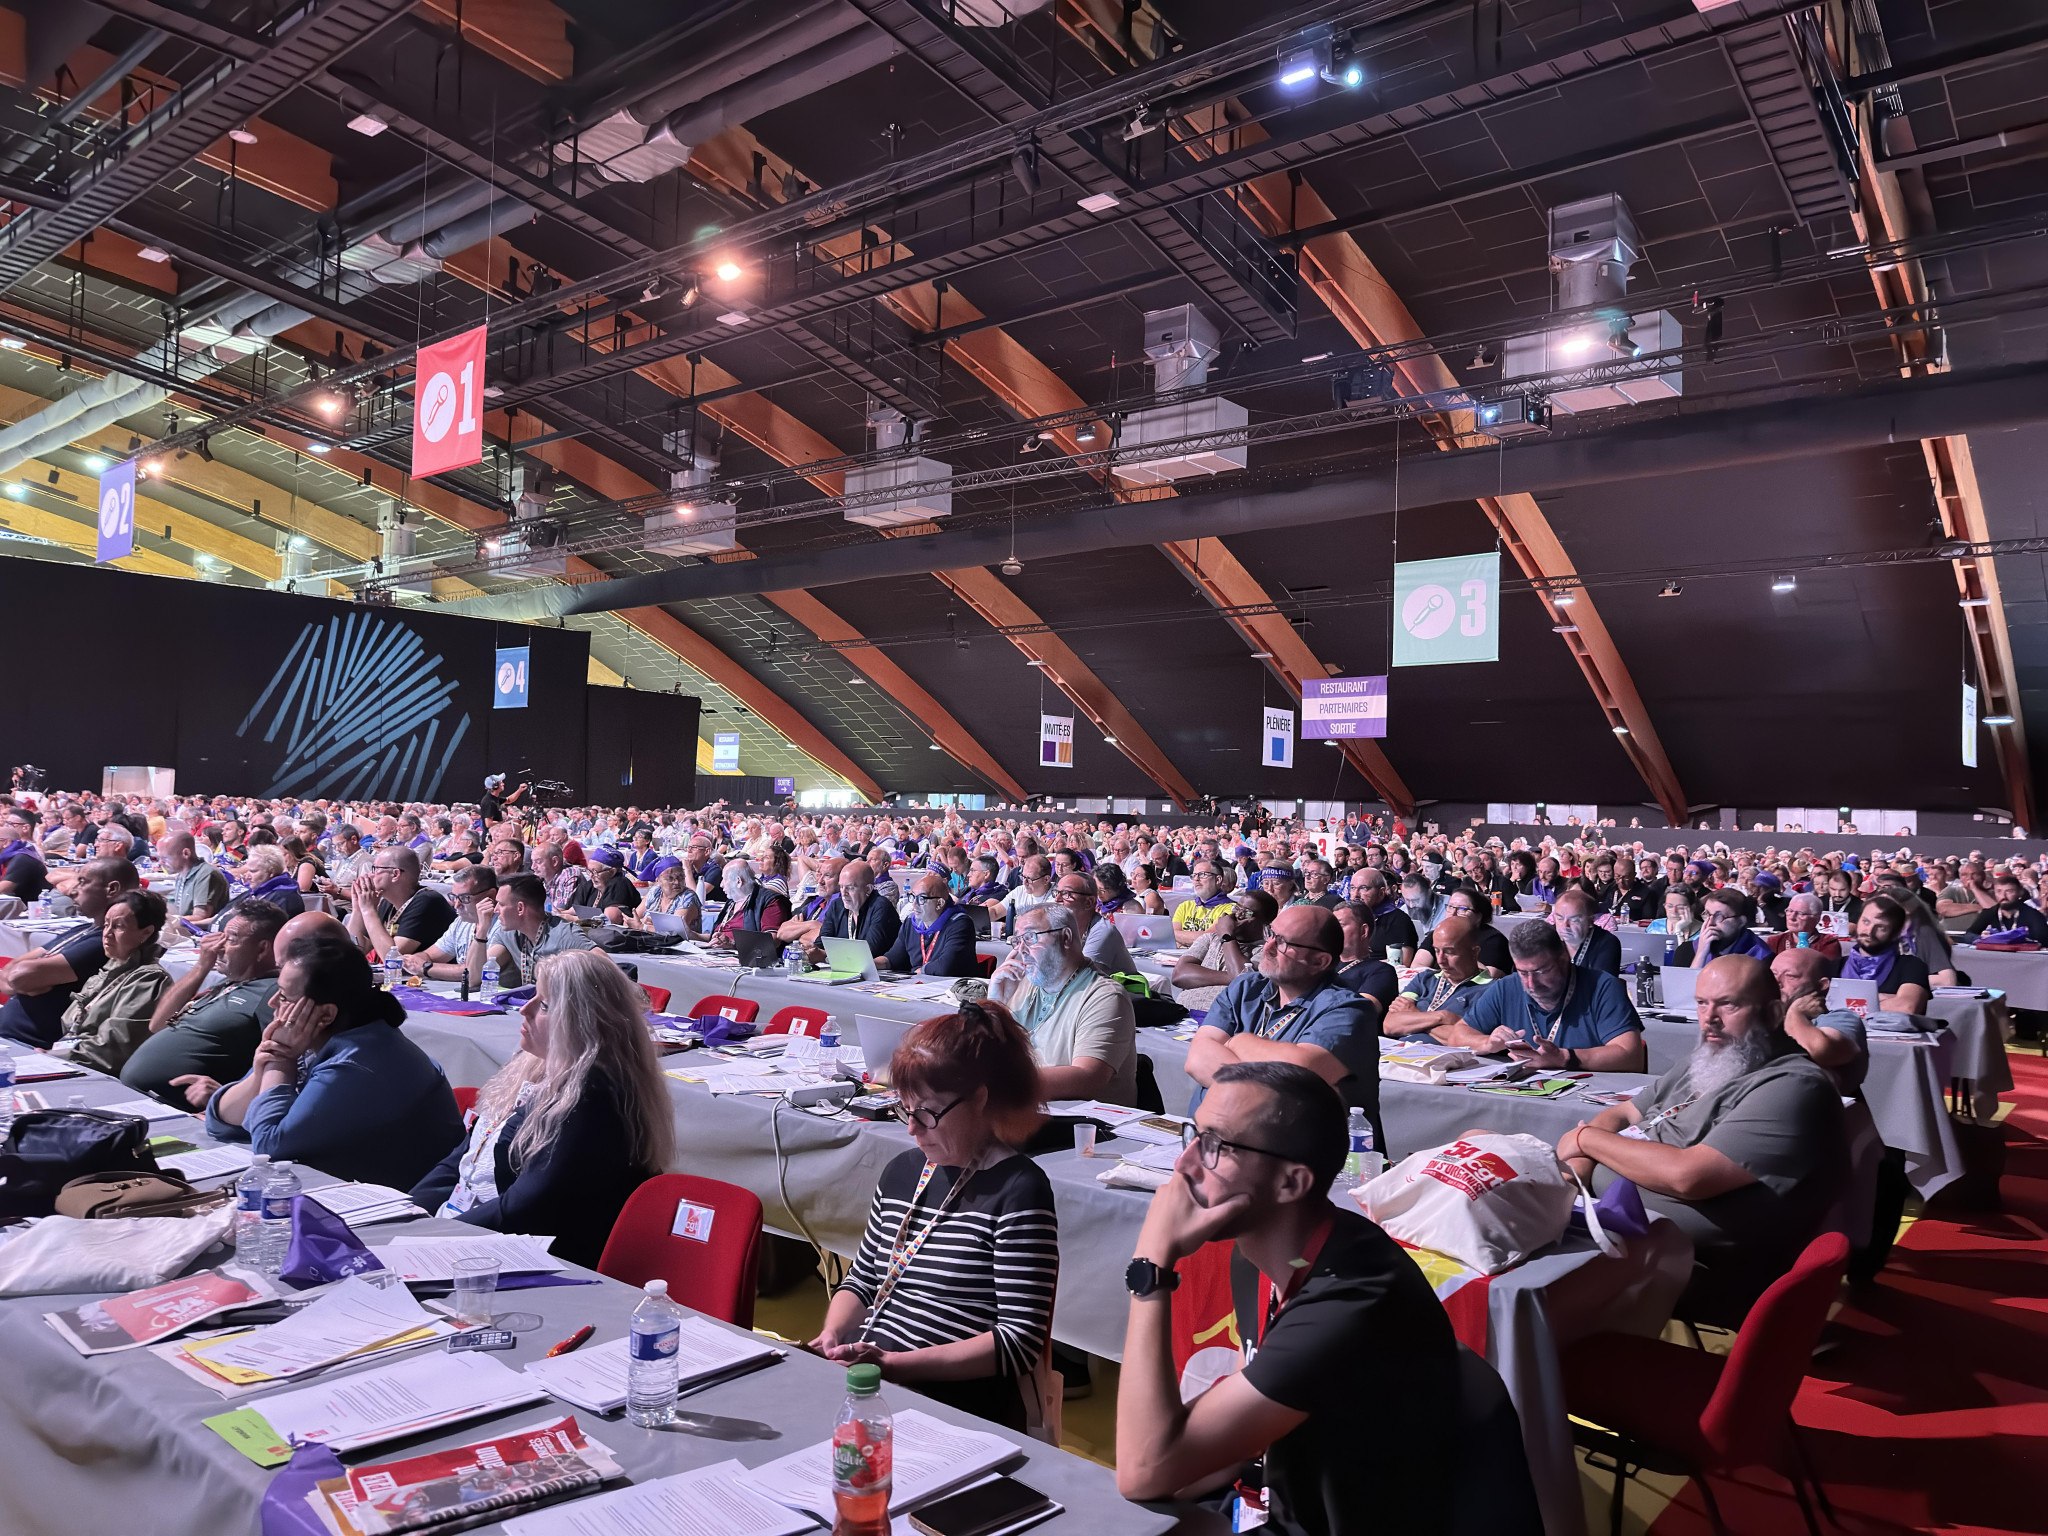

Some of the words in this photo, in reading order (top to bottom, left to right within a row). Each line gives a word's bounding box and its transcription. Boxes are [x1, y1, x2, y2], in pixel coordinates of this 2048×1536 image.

[458, 360, 476, 435] 1
[119, 482, 131, 535] 2
[1460, 579, 1487, 637] 3
[515, 660, 526, 693] 4
[1320, 681, 1369, 694] RESTAURANT
[1319, 701, 1369, 714] PARTENAIRES
[1266, 714, 1291, 732] PLÉNIÈRE
[1330, 722, 1357, 735] SORTIE
[1318, 838, 1327, 857] 3
[1466, 1159, 1505, 1188] cgt
[834, 1446, 867, 1467] Volvic
